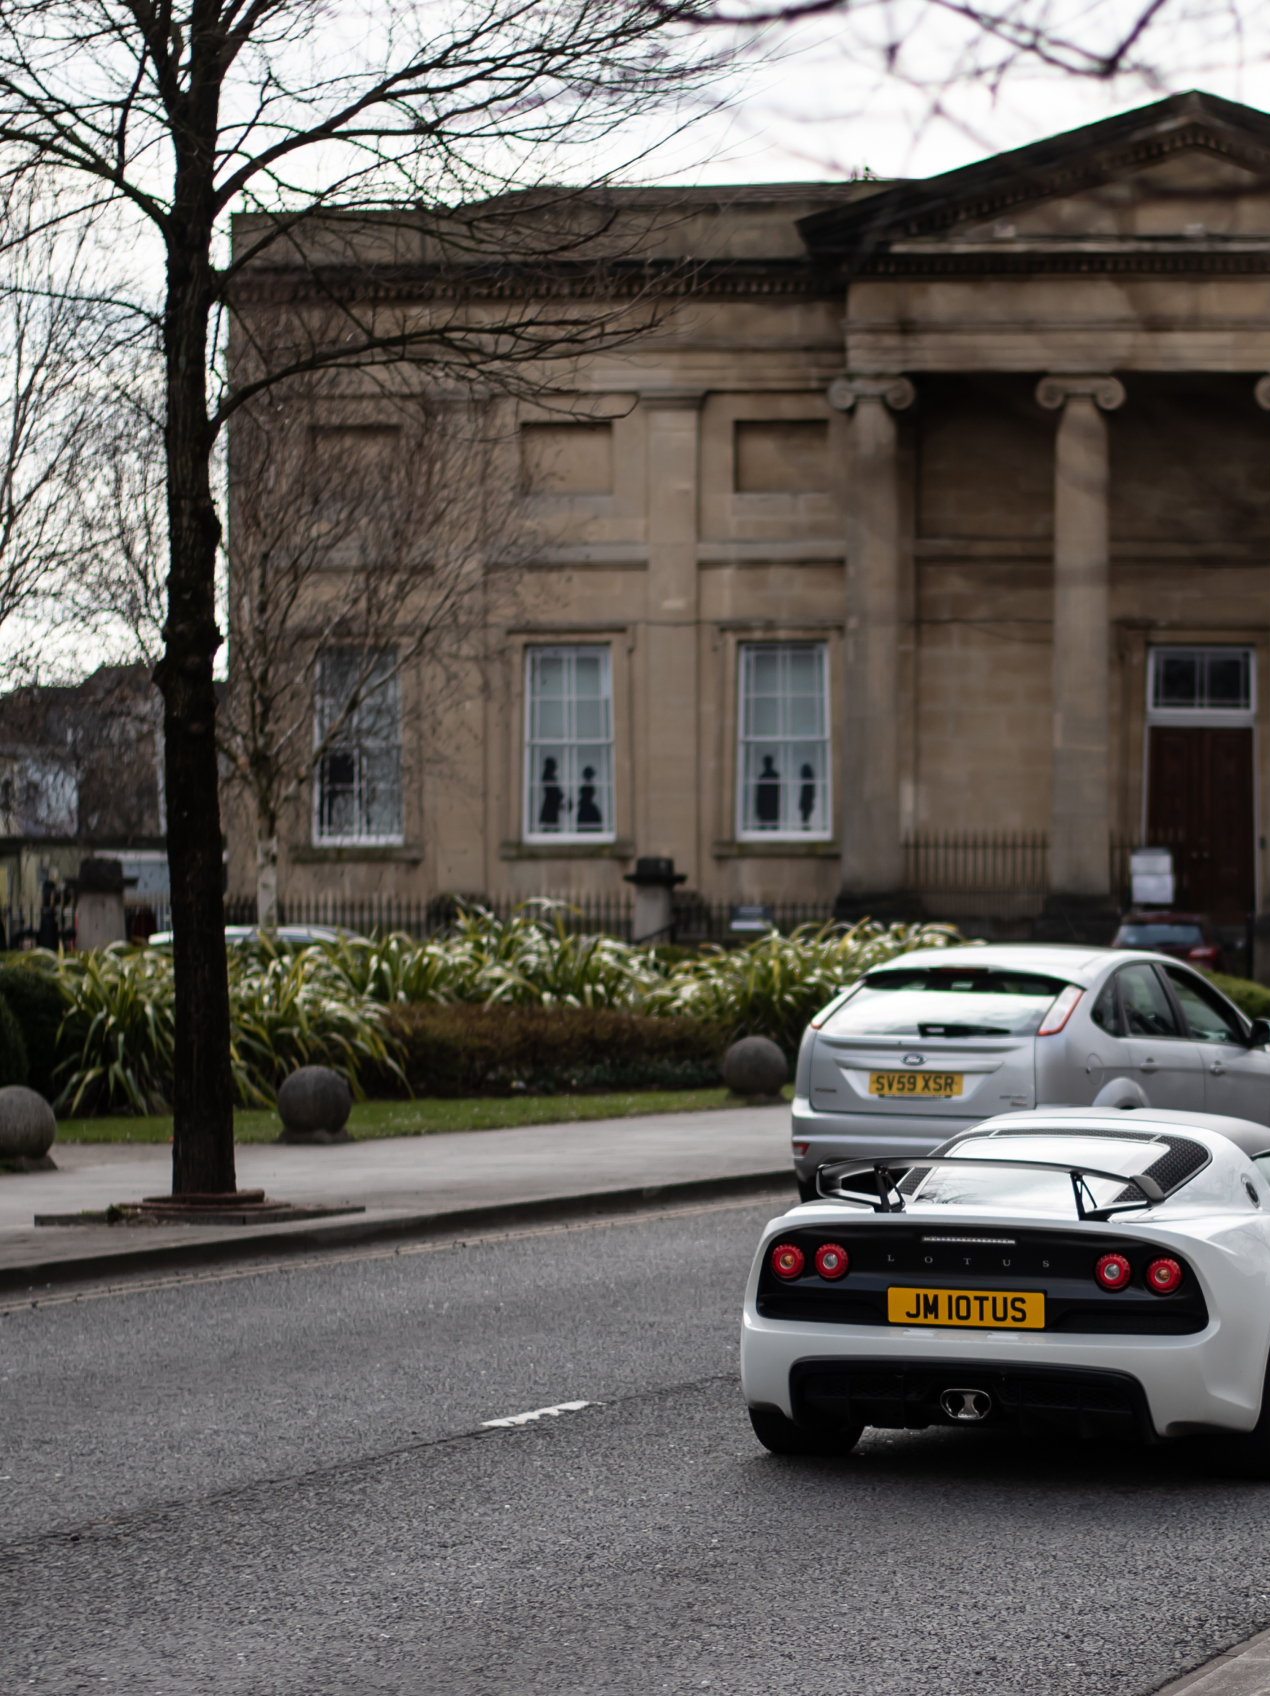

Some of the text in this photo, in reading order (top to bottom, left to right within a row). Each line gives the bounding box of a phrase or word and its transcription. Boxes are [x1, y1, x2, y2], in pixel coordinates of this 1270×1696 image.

[876, 1075, 955, 1092] SV59 XSR
[887, 1253, 1050, 1269] LOTUS
